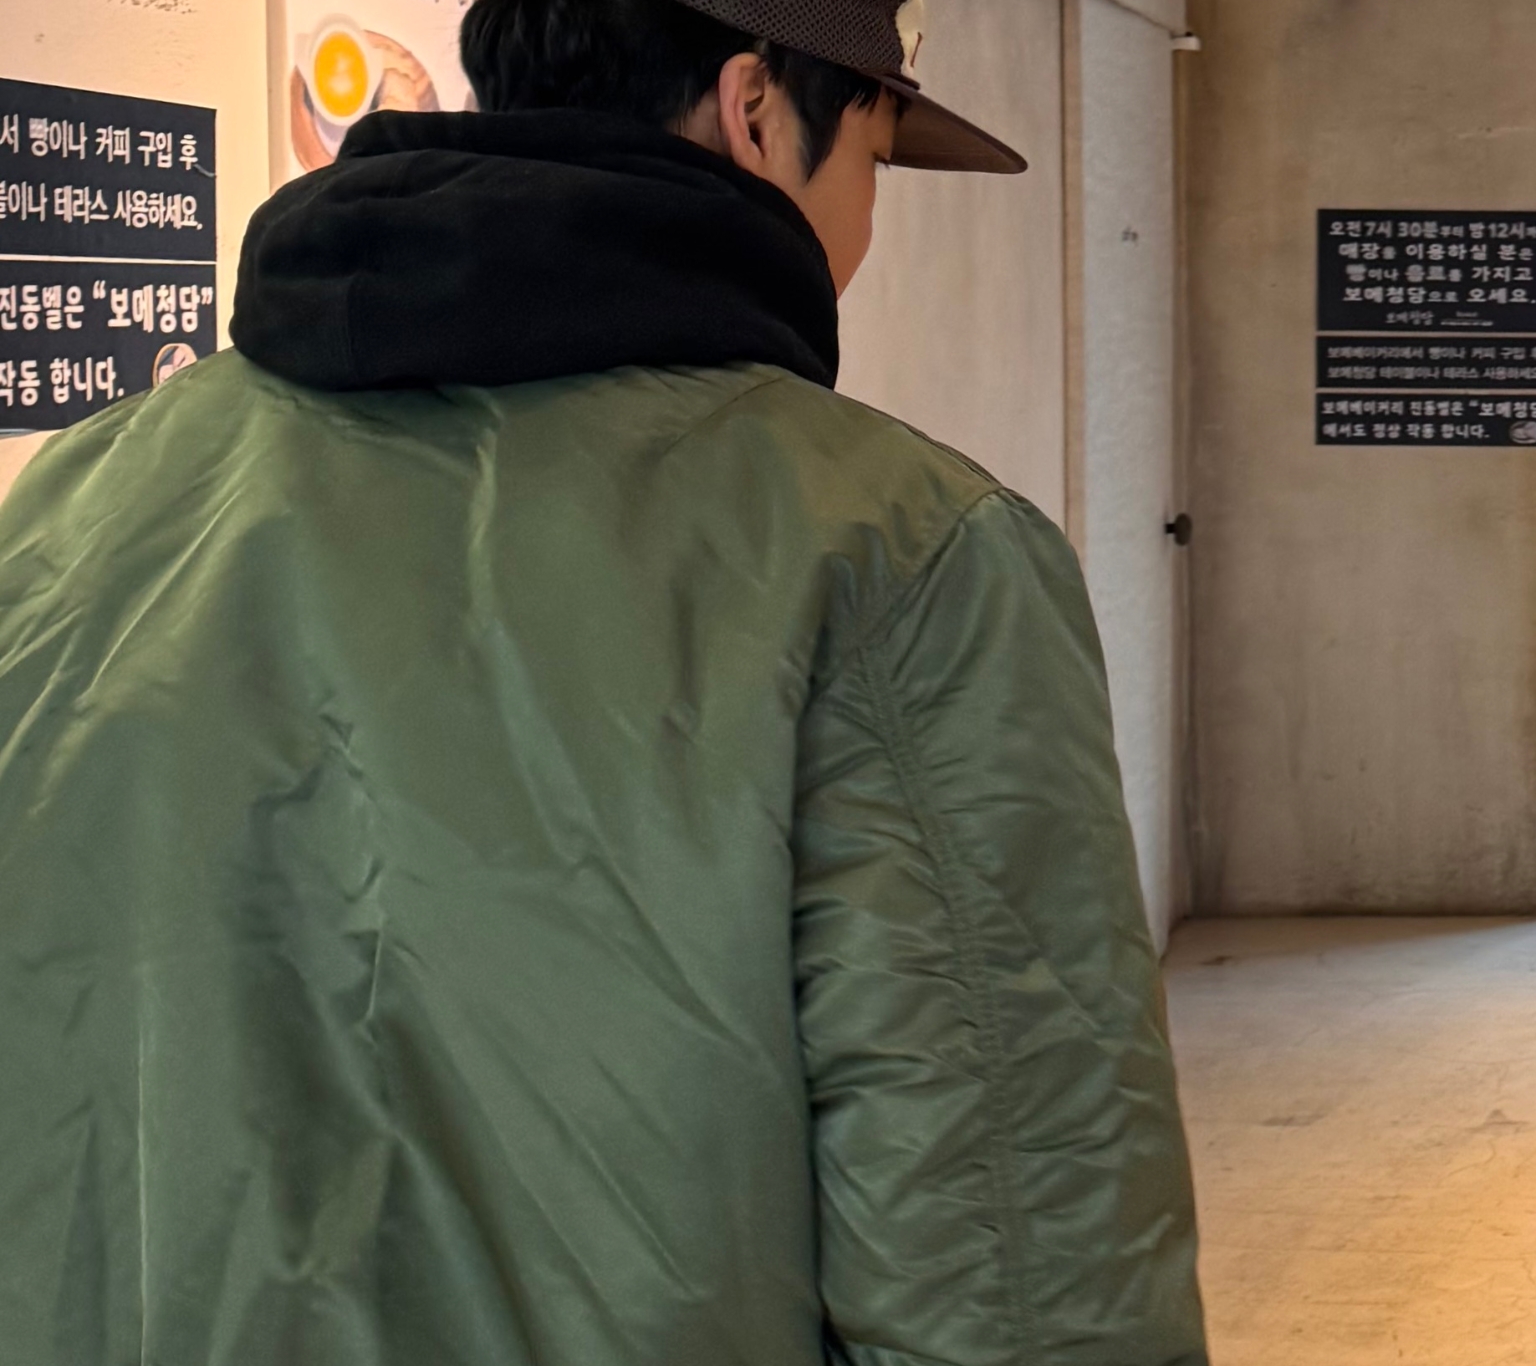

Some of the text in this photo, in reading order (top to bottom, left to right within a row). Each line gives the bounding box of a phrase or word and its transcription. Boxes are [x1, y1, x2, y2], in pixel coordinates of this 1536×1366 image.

[29, 117, 86, 160] 빵이나
[95, 126, 131, 165] 커피
[138, 131, 173, 169] 구입
[180, 134, 199, 170] 후
[54, 185, 110, 225] 테라스
[113, 190, 203, 231] 사용하세요.
[1345, 264, 1398, 282] 빵이나
[1471, 266, 1534, 282] 가지고
[1405, 243, 1488, 261] 이용하실
[1497, 244, 1534, 261] 분은
[0, 284, 85, 331] 진동벨은
[1466, 287, 1536, 304] 오세요.
[50, 356, 124, 407] 합니다.
